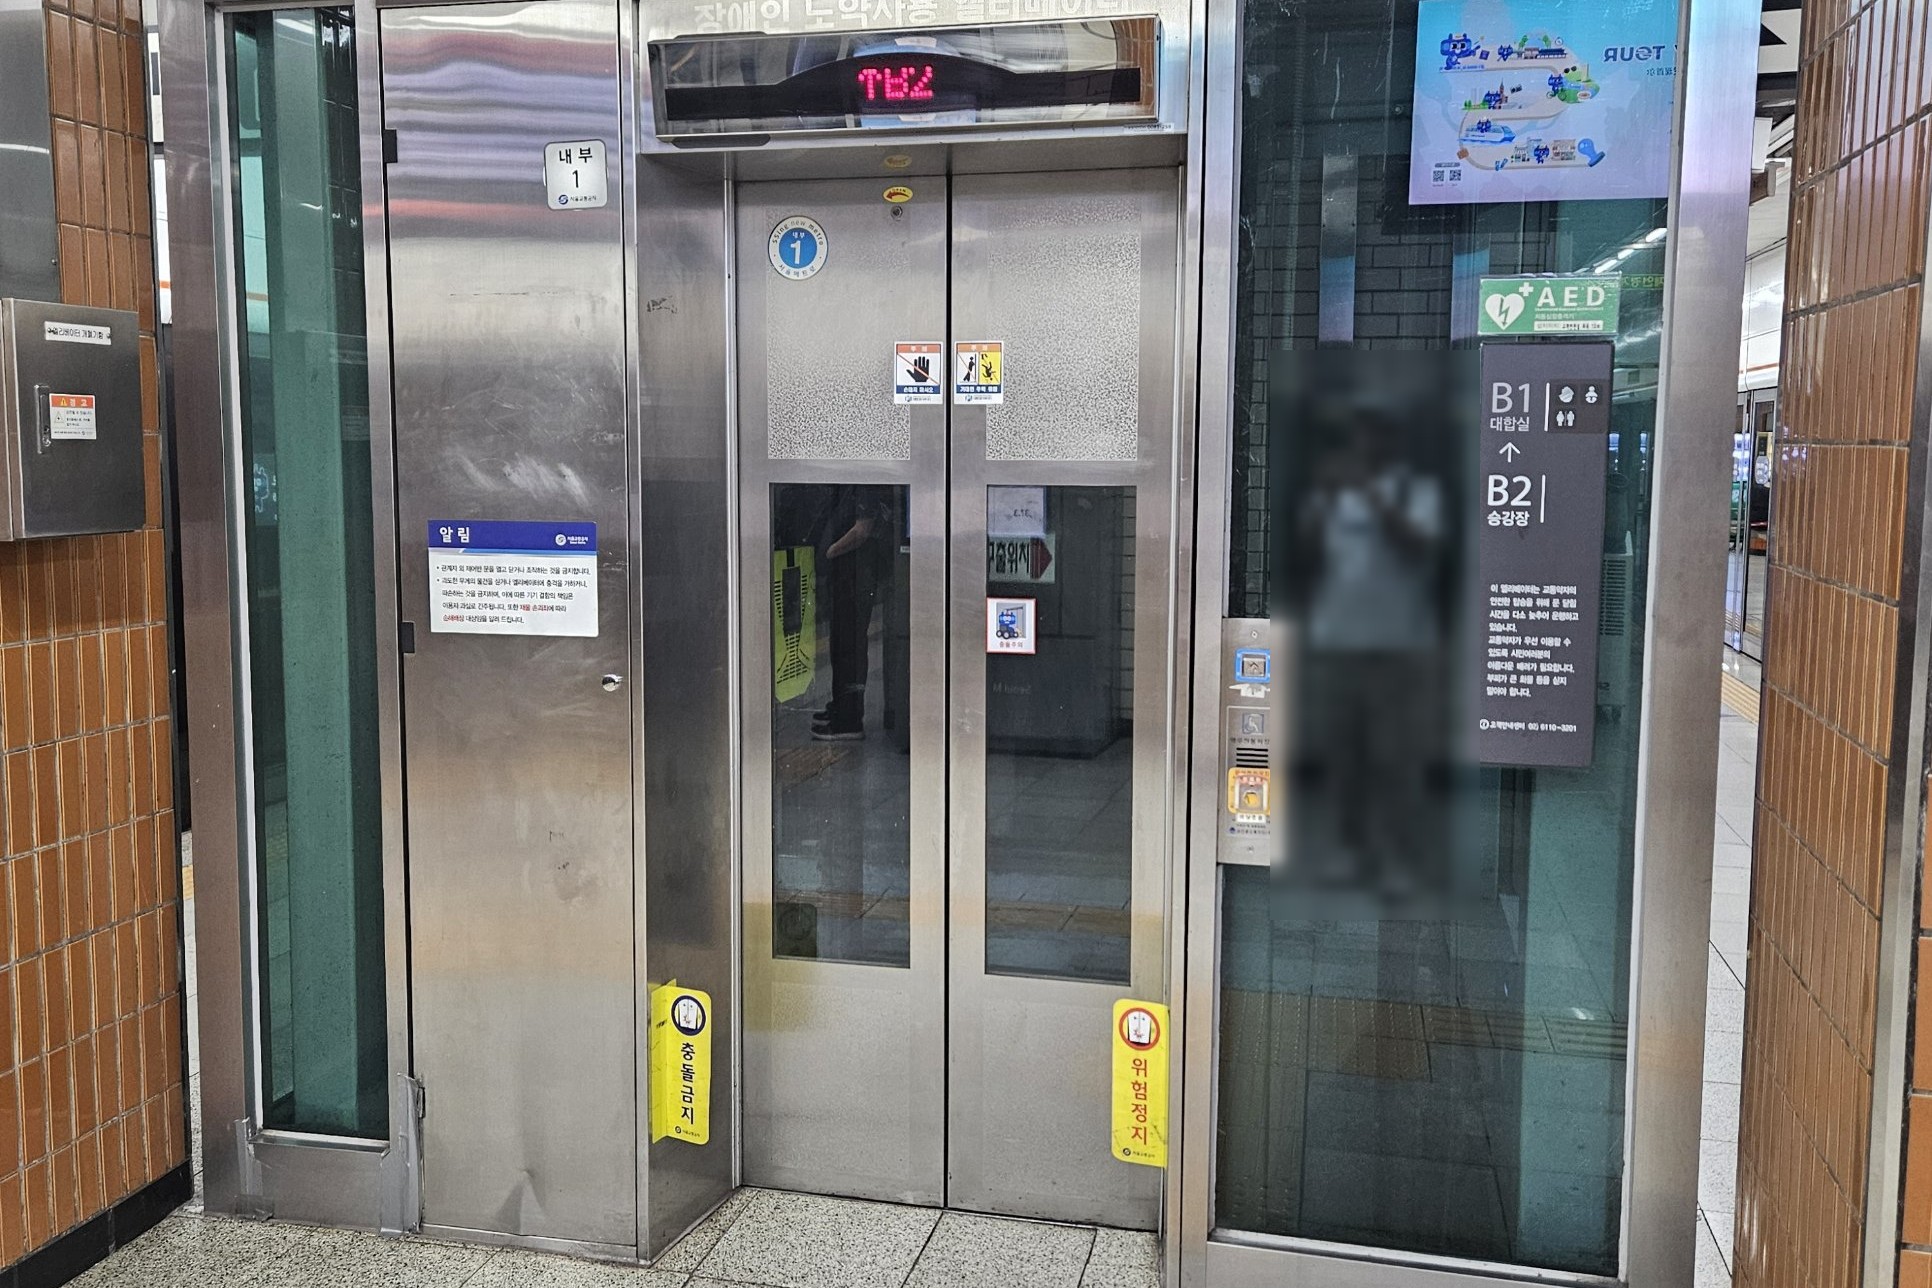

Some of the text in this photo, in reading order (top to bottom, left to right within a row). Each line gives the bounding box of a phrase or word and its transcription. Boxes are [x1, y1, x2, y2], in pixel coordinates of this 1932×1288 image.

[694, 0, 790, 33] 장애인
[559, 147, 593, 164] 내부
[572, 170, 579, 188] 1
[790, 240, 801, 265] 1
[1536, 286, 1605, 307] AED
[1491, 382, 1530, 414] B1
[1490, 416, 1530, 432] 대합실
[1487, 474, 1532, 507] B2
[1487, 510, 1530, 527] 승강장
[439, 526, 470, 543] 알림
[1490, 584, 1498, 593] 이
[680, 1042, 696, 1125] 충돌금지
[1131, 1058, 1148, 1146] 위험정지
